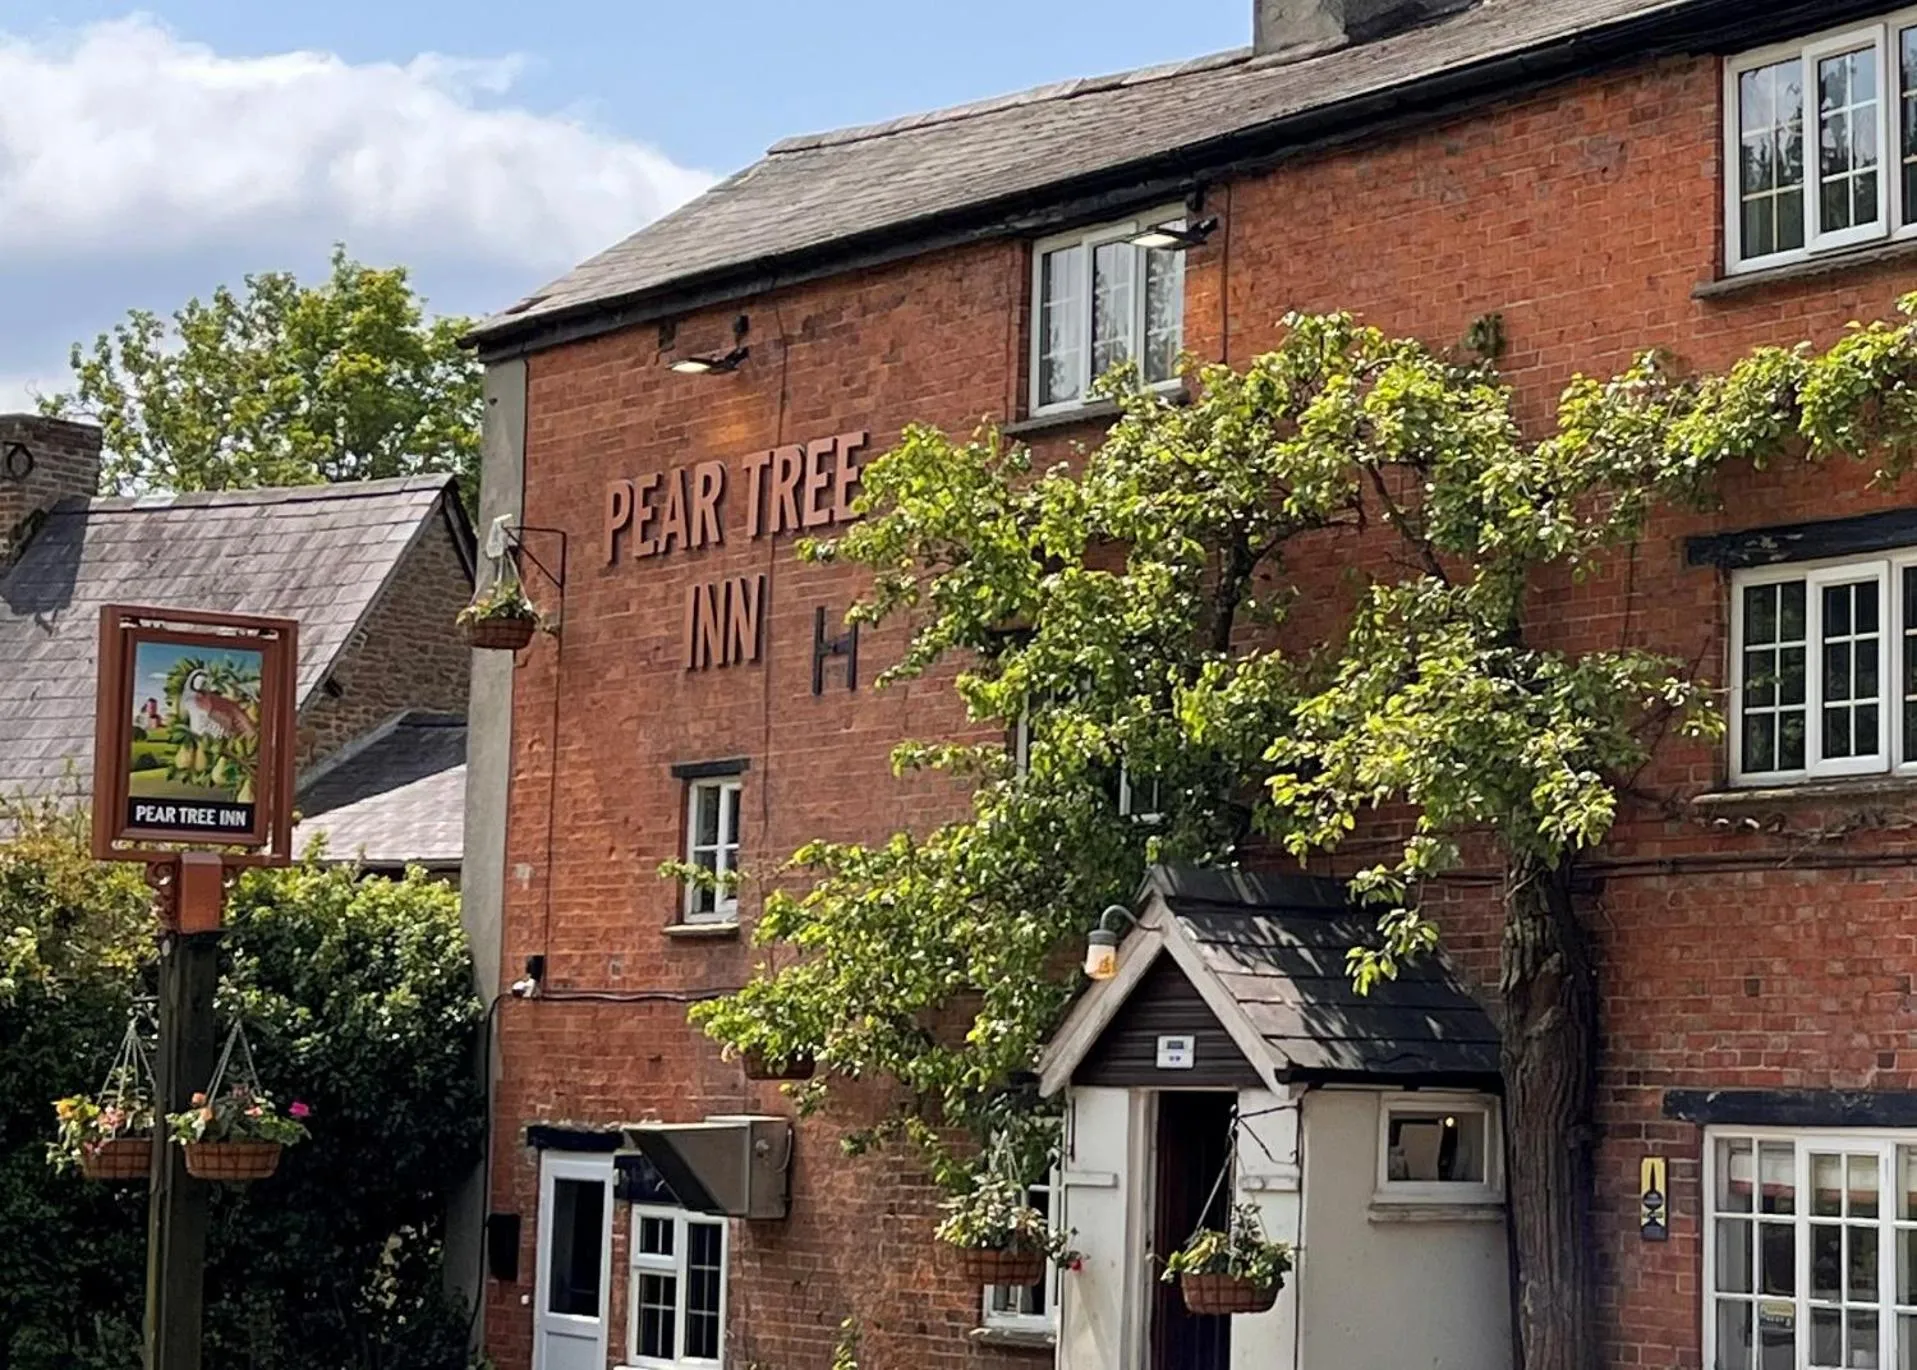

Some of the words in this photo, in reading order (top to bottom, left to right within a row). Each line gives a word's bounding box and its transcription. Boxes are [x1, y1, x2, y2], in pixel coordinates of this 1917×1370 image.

[605, 460, 726, 565] PEAR
[742, 430, 869, 537] TREE
[685, 574, 768, 671] INN
[135, 805, 176, 823] PEAR
[178, 807, 216, 825] TREE
[219, 809, 247, 826] INN
